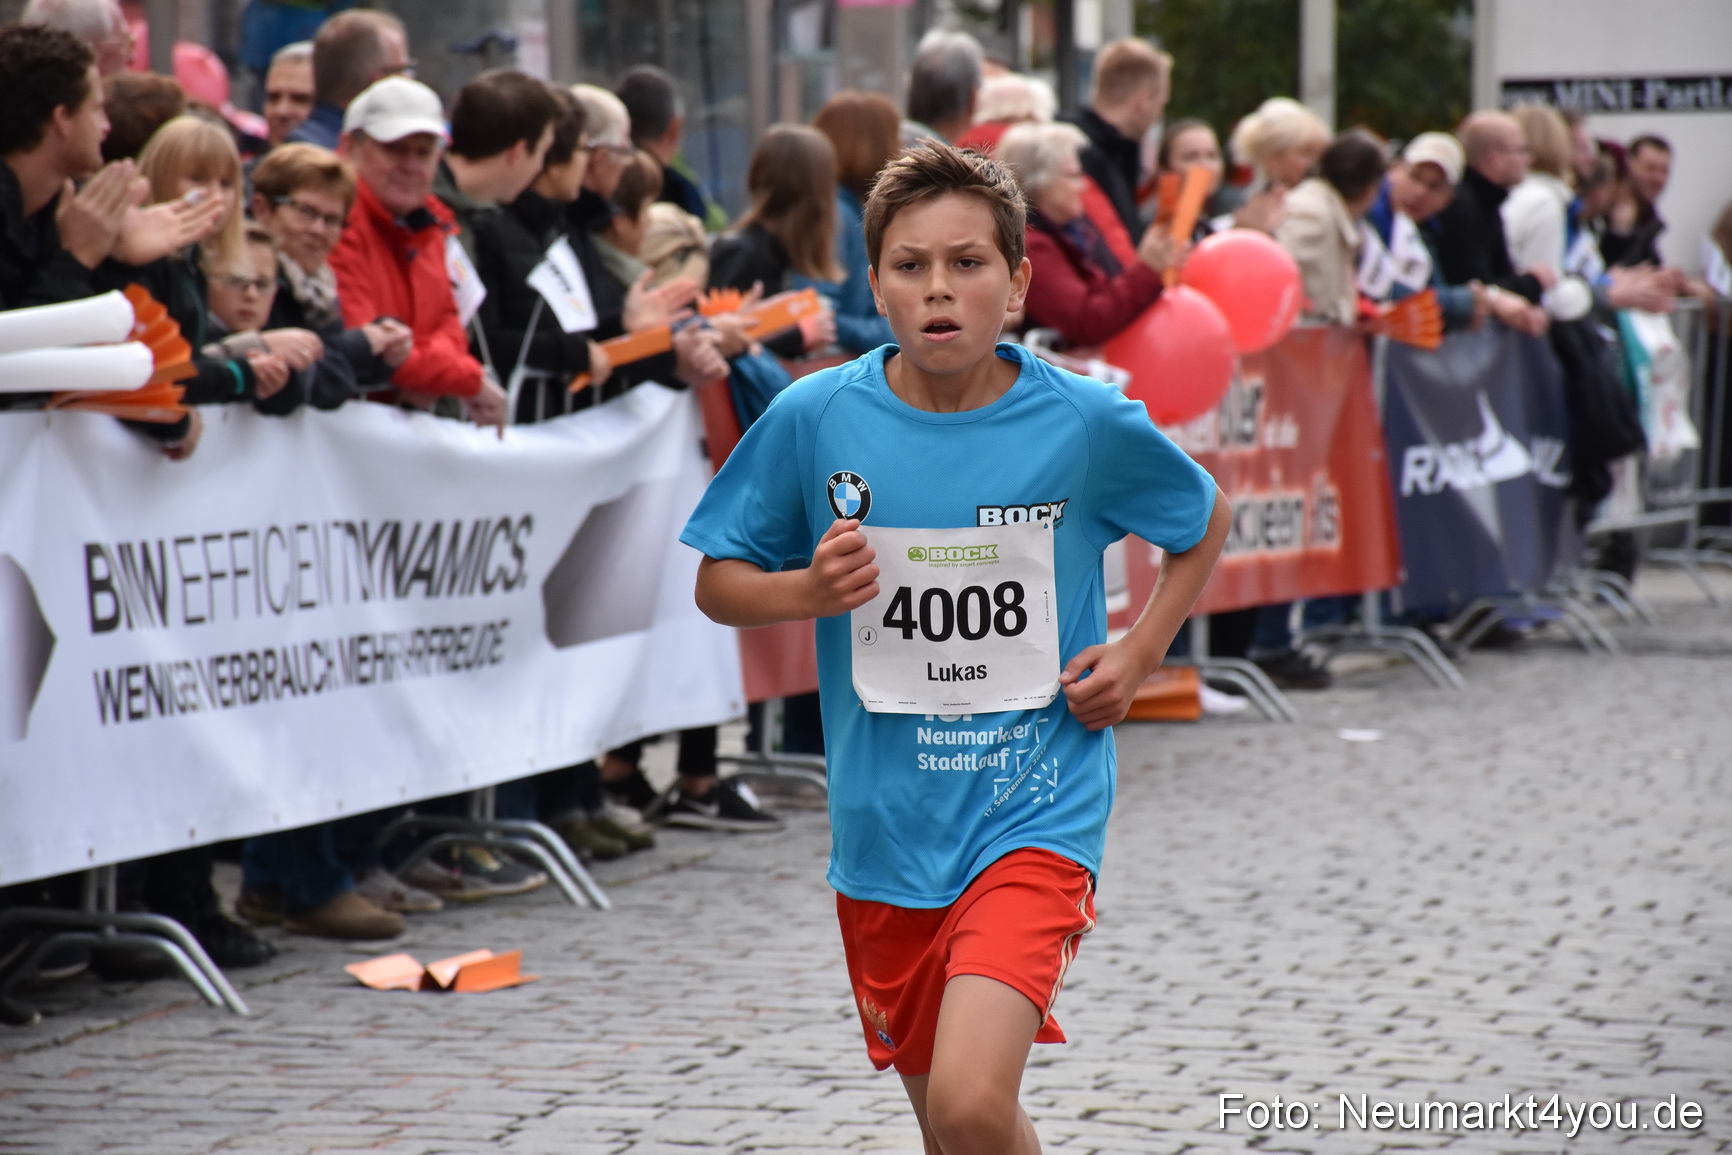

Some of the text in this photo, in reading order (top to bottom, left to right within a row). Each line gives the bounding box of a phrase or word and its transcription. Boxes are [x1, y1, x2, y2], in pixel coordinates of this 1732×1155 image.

[828, 473, 867, 492] BMW
[978, 499, 1067, 526] BOCK
[929, 544, 998, 561] BOCK
[882, 580, 1028, 642] 4008
[864, 631, 871, 641] J
[927, 662, 988, 682] Lukas
[917, 747, 1011, 771] Stadtlauf
[983, 806, 997, 818] 17.
[994, 765, 1033, 807] September
